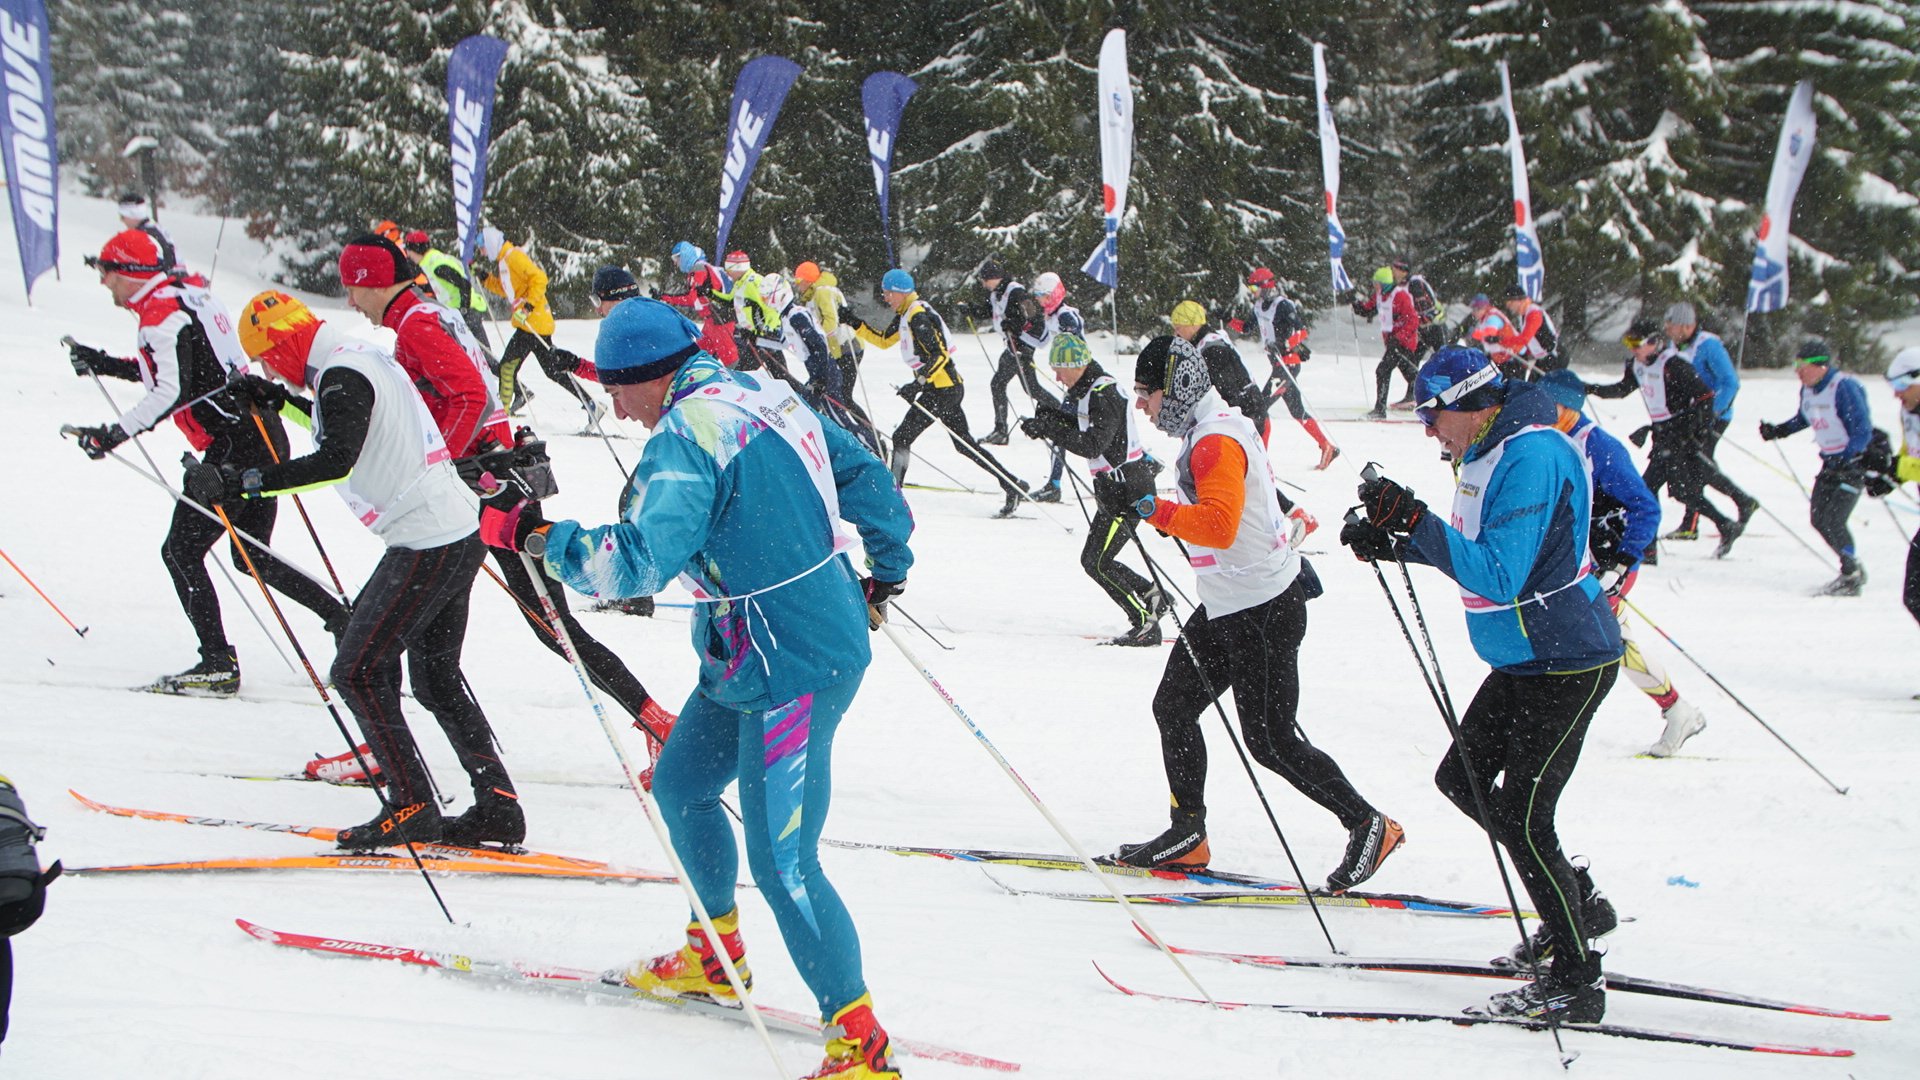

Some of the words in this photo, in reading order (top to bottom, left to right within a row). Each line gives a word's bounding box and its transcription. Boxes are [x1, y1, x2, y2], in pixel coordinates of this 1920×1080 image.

[1152, 831, 1201, 862] ROSSIGNOL
[1349, 815, 1380, 882] ROSSIGNOL
[319, 938, 410, 957] ATOMIC
